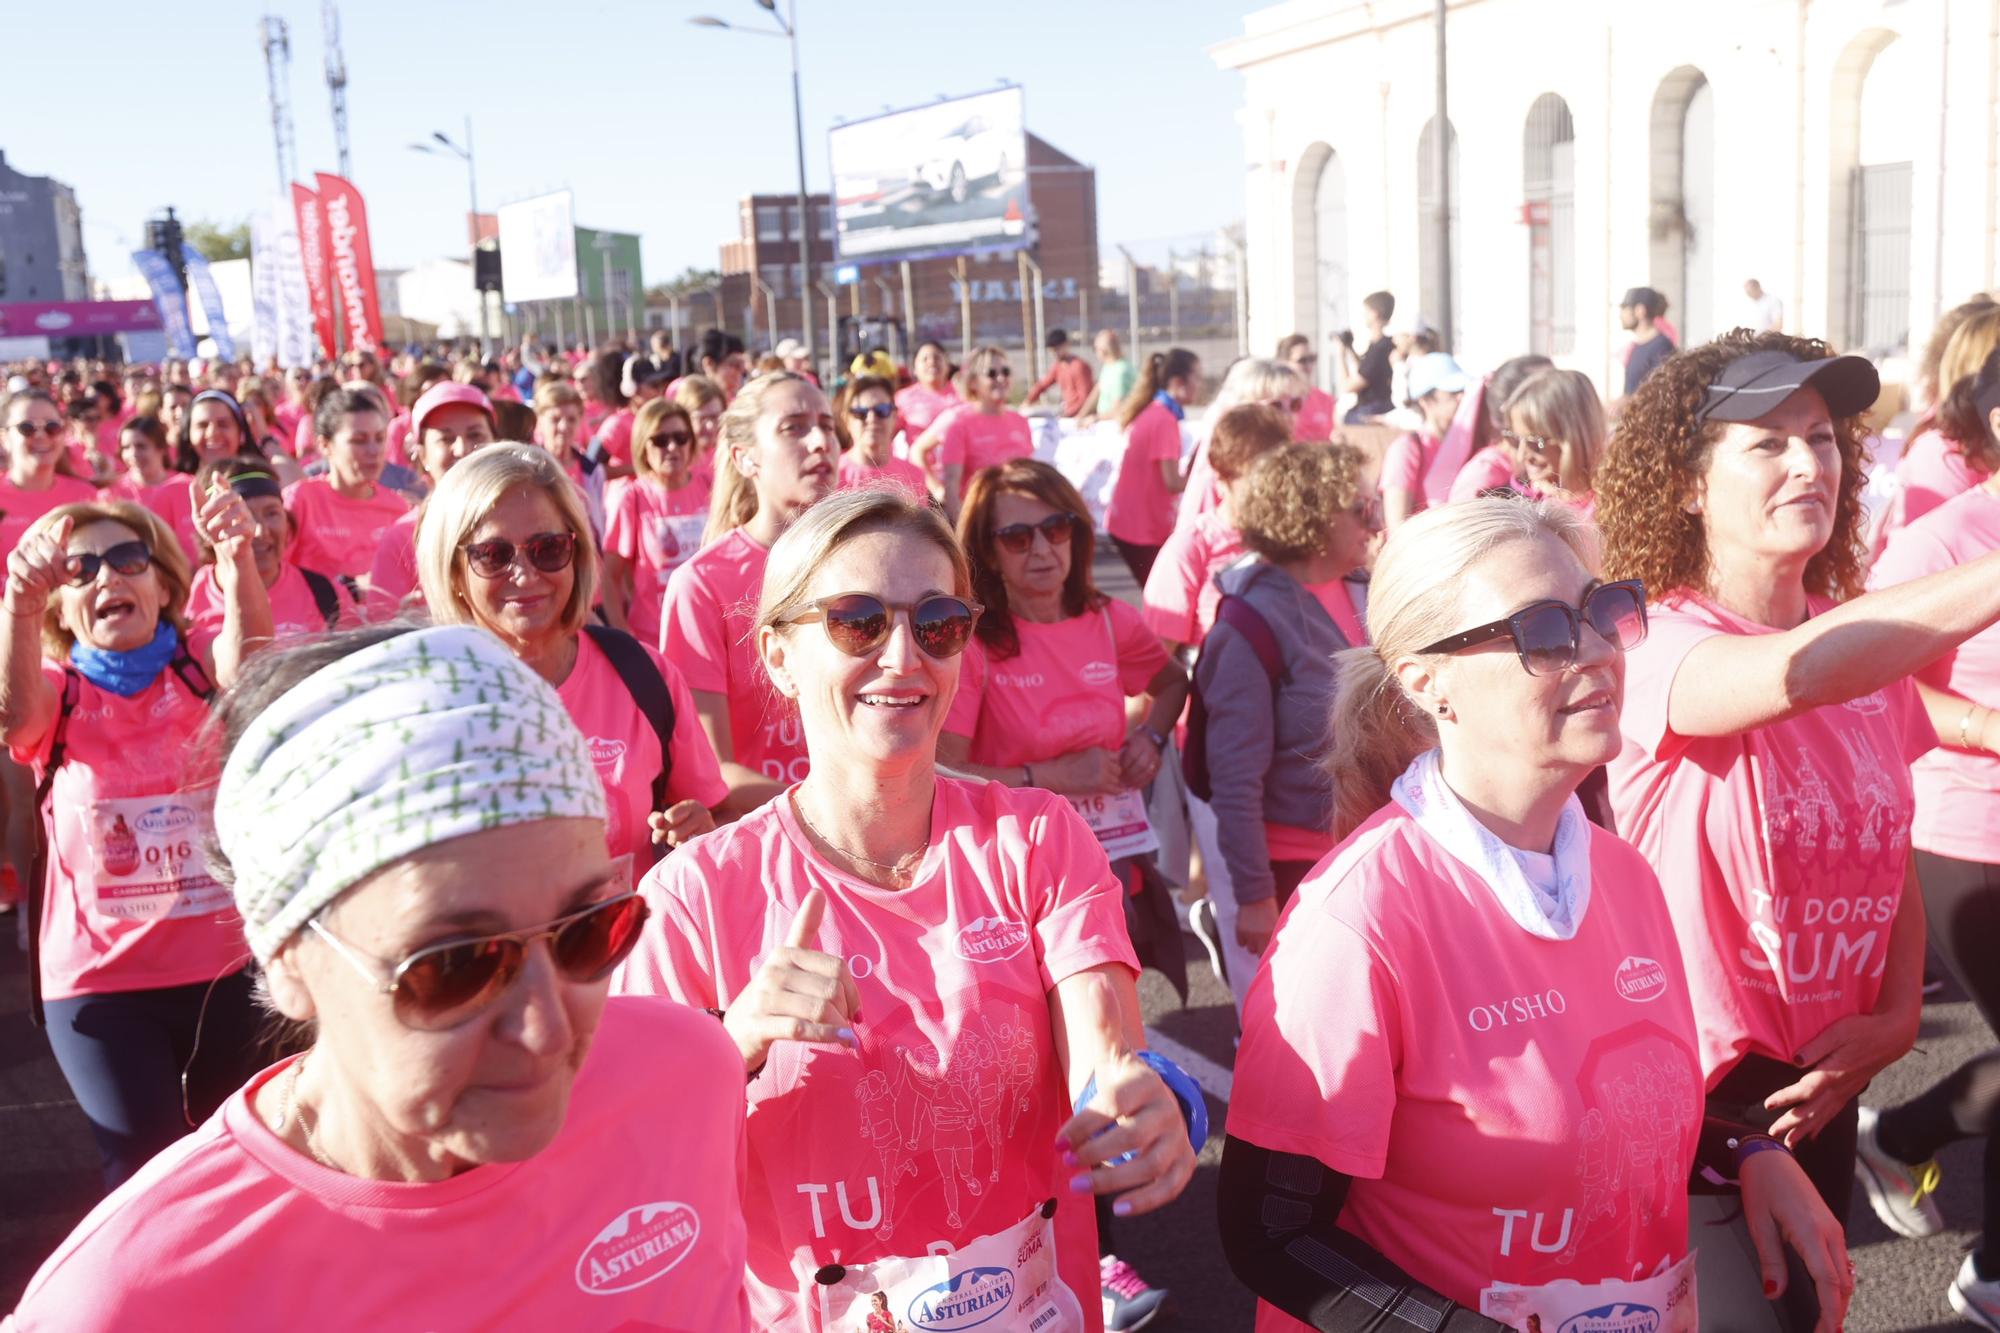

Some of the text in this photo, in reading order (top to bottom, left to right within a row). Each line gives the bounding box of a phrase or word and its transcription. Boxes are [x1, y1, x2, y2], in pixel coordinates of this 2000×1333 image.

[1619, 970, 1665, 995] ASTURIANA
[1468, 988, 1566, 1031] OYSHO
[797, 1176, 882, 1238] TU
[1017, 1236, 1043, 1268] SUMA
[1493, 1207, 1574, 1257] TU
[590, 1220, 694, 1288] ASTURIANA
[918, 1282, 1011, 1323] ASTURIANA
[975, 1274, 1008, 1293] LECHERA
